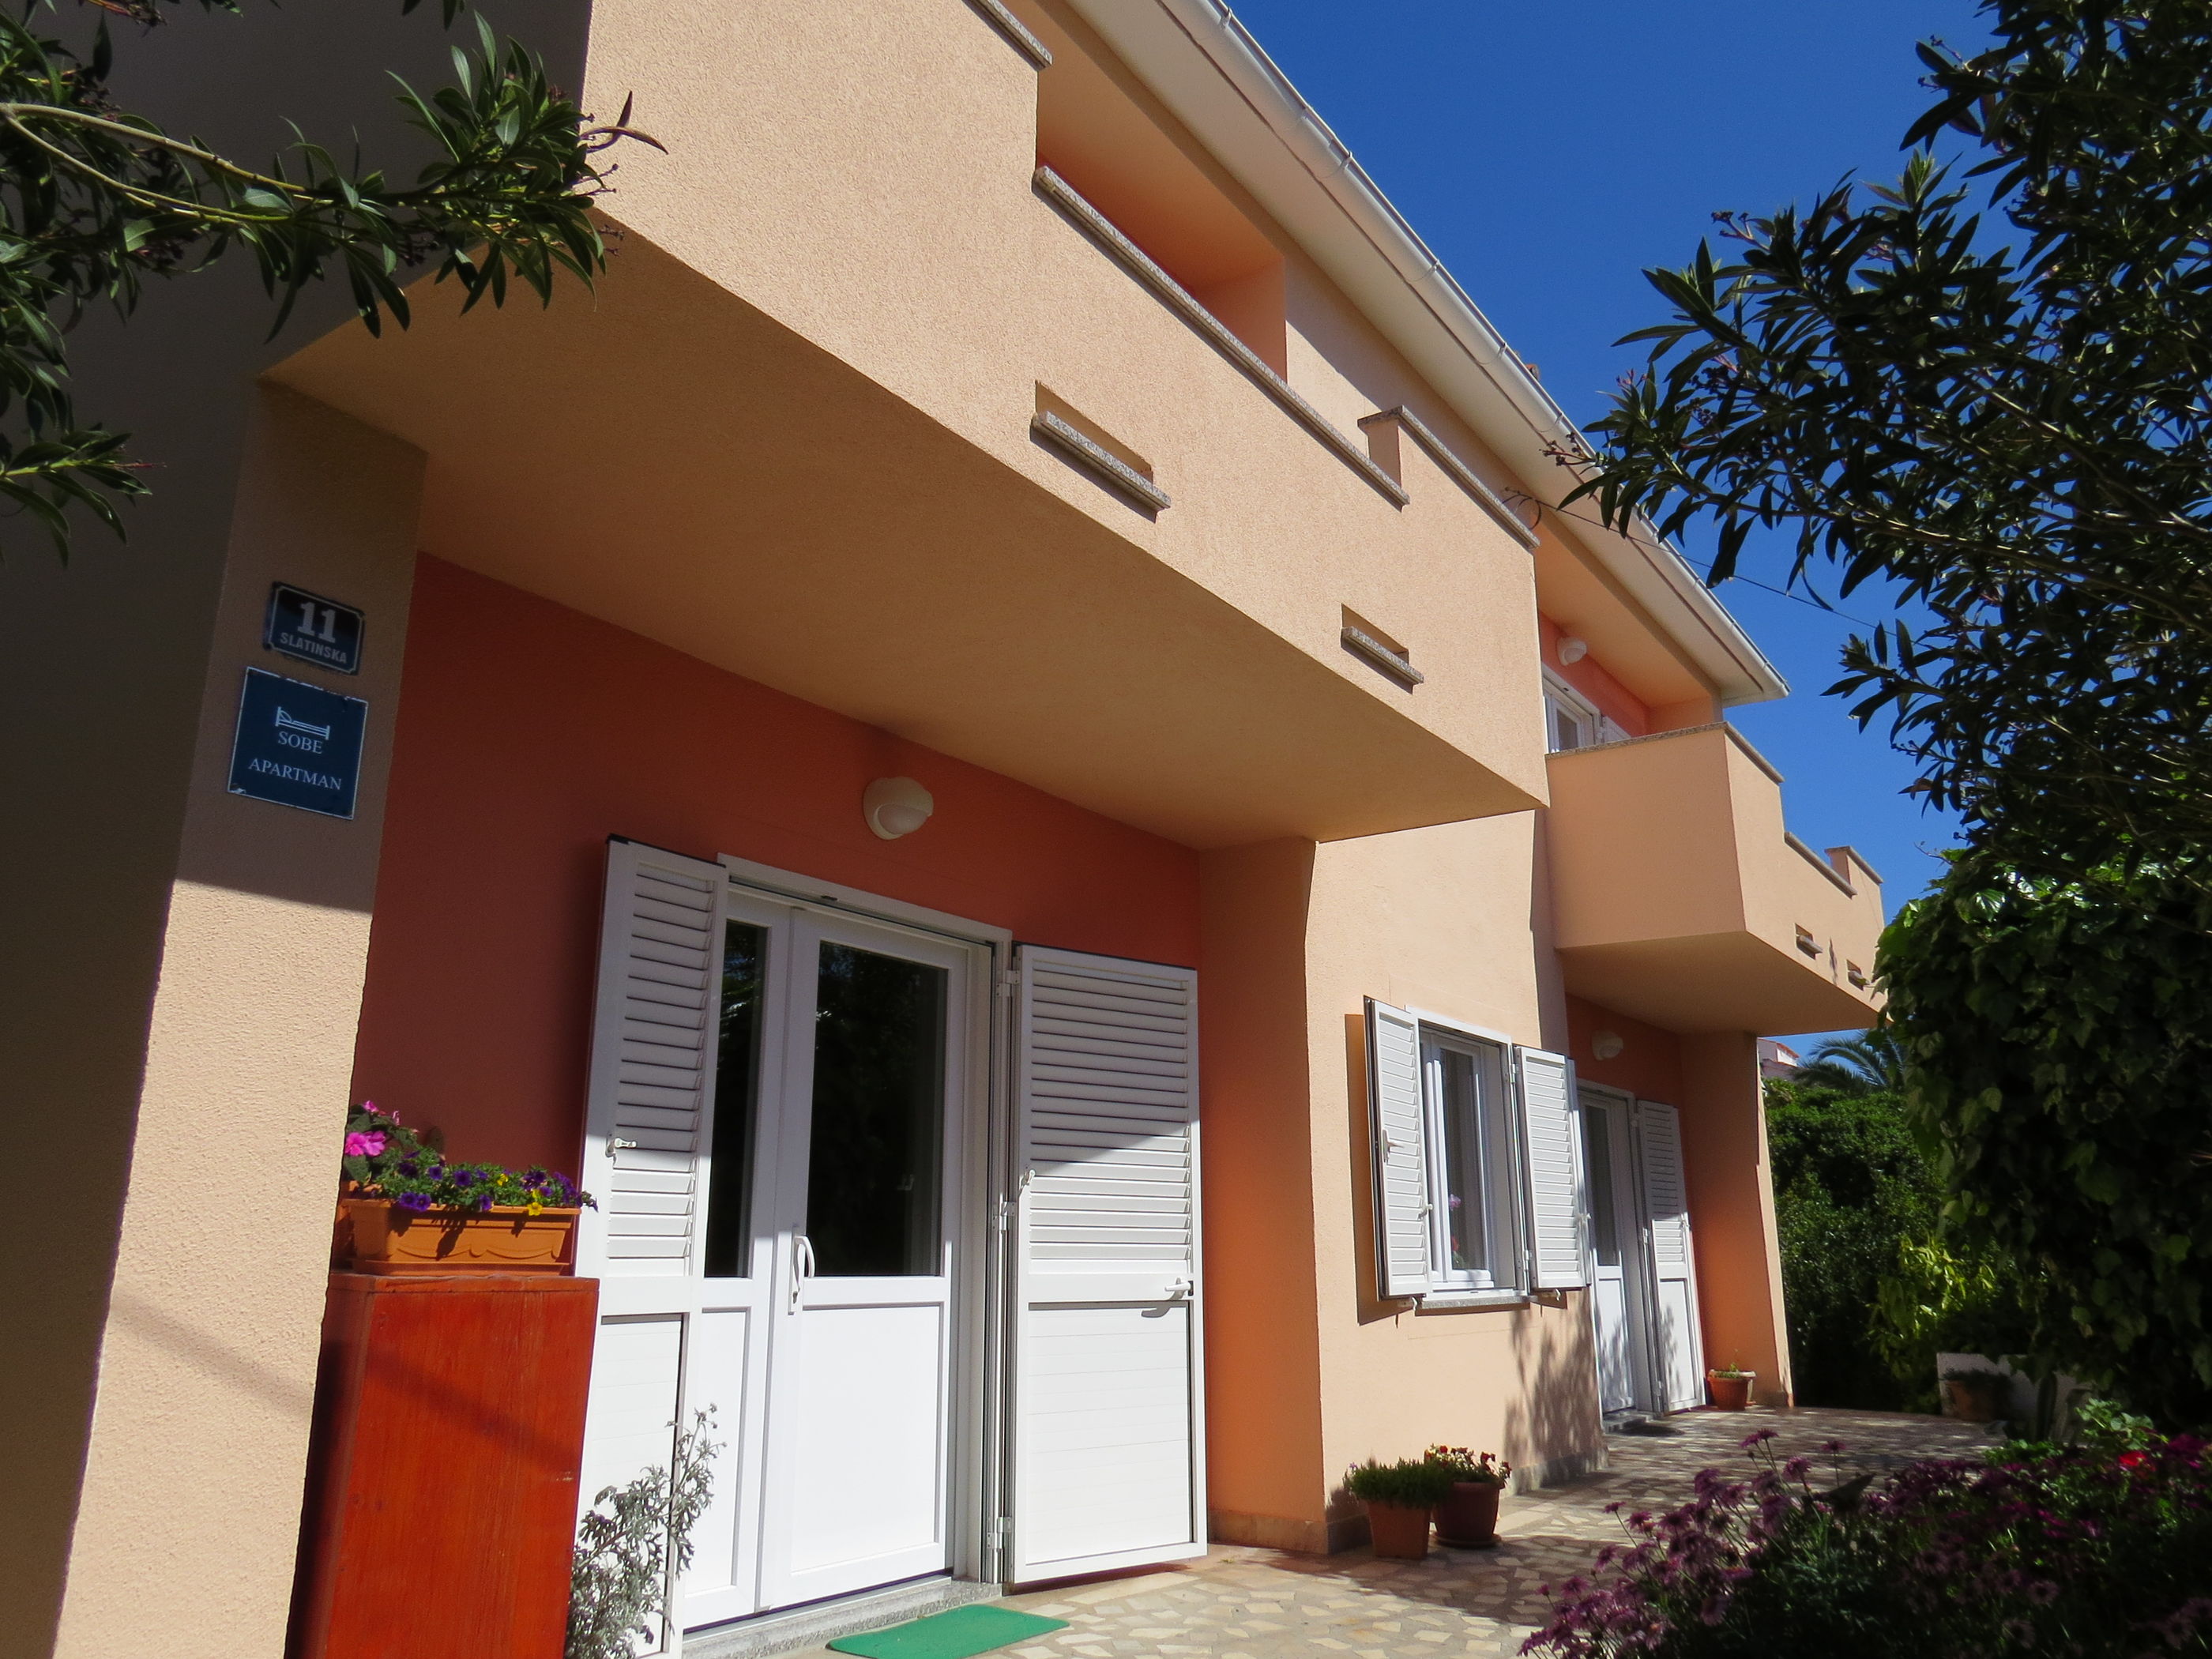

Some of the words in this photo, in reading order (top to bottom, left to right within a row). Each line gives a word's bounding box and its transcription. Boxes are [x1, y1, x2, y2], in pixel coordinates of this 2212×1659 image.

[297, 602, 337, 643] 11
[280, 632, 347, 664] SLATINSKA
[278, 731, 323, 754] SOBE
[248, 758, 342, 790] APARTMAN
